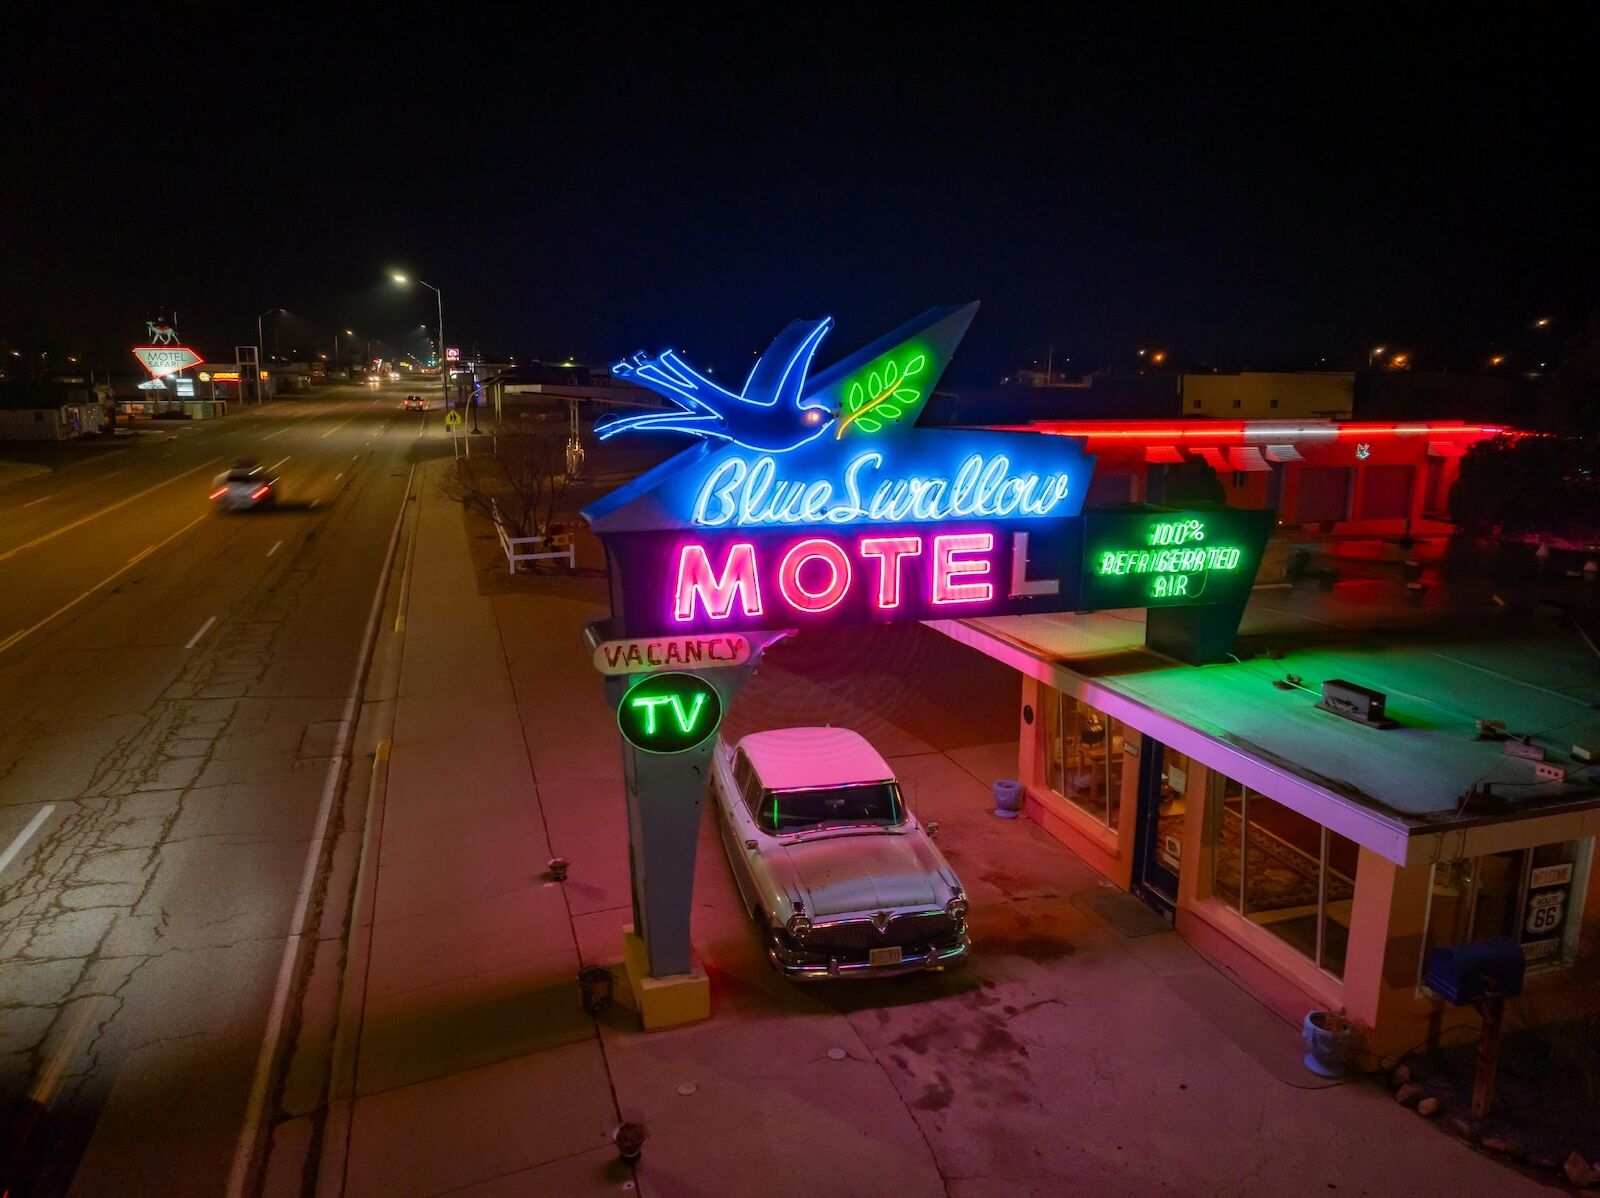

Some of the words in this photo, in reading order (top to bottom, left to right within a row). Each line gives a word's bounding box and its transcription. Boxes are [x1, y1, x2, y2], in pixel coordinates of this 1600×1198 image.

[147, 352, 186, 362] MOTEL
[693, 456, 832, 527] Blue
[830, 452, 1069, 521] Swallow
[1149, 519, 1205, 546] 100%
[1099, 548, 1241, 576] REFRIGERATED
[675, 532, 1060, 622] MOTEL
[1153, 574, 1190, 598] AIR
[604, 638, 742, 668] VACANCY
[632, 692, 706, 735] TV
[1535, 907, 1556, 928] 66
